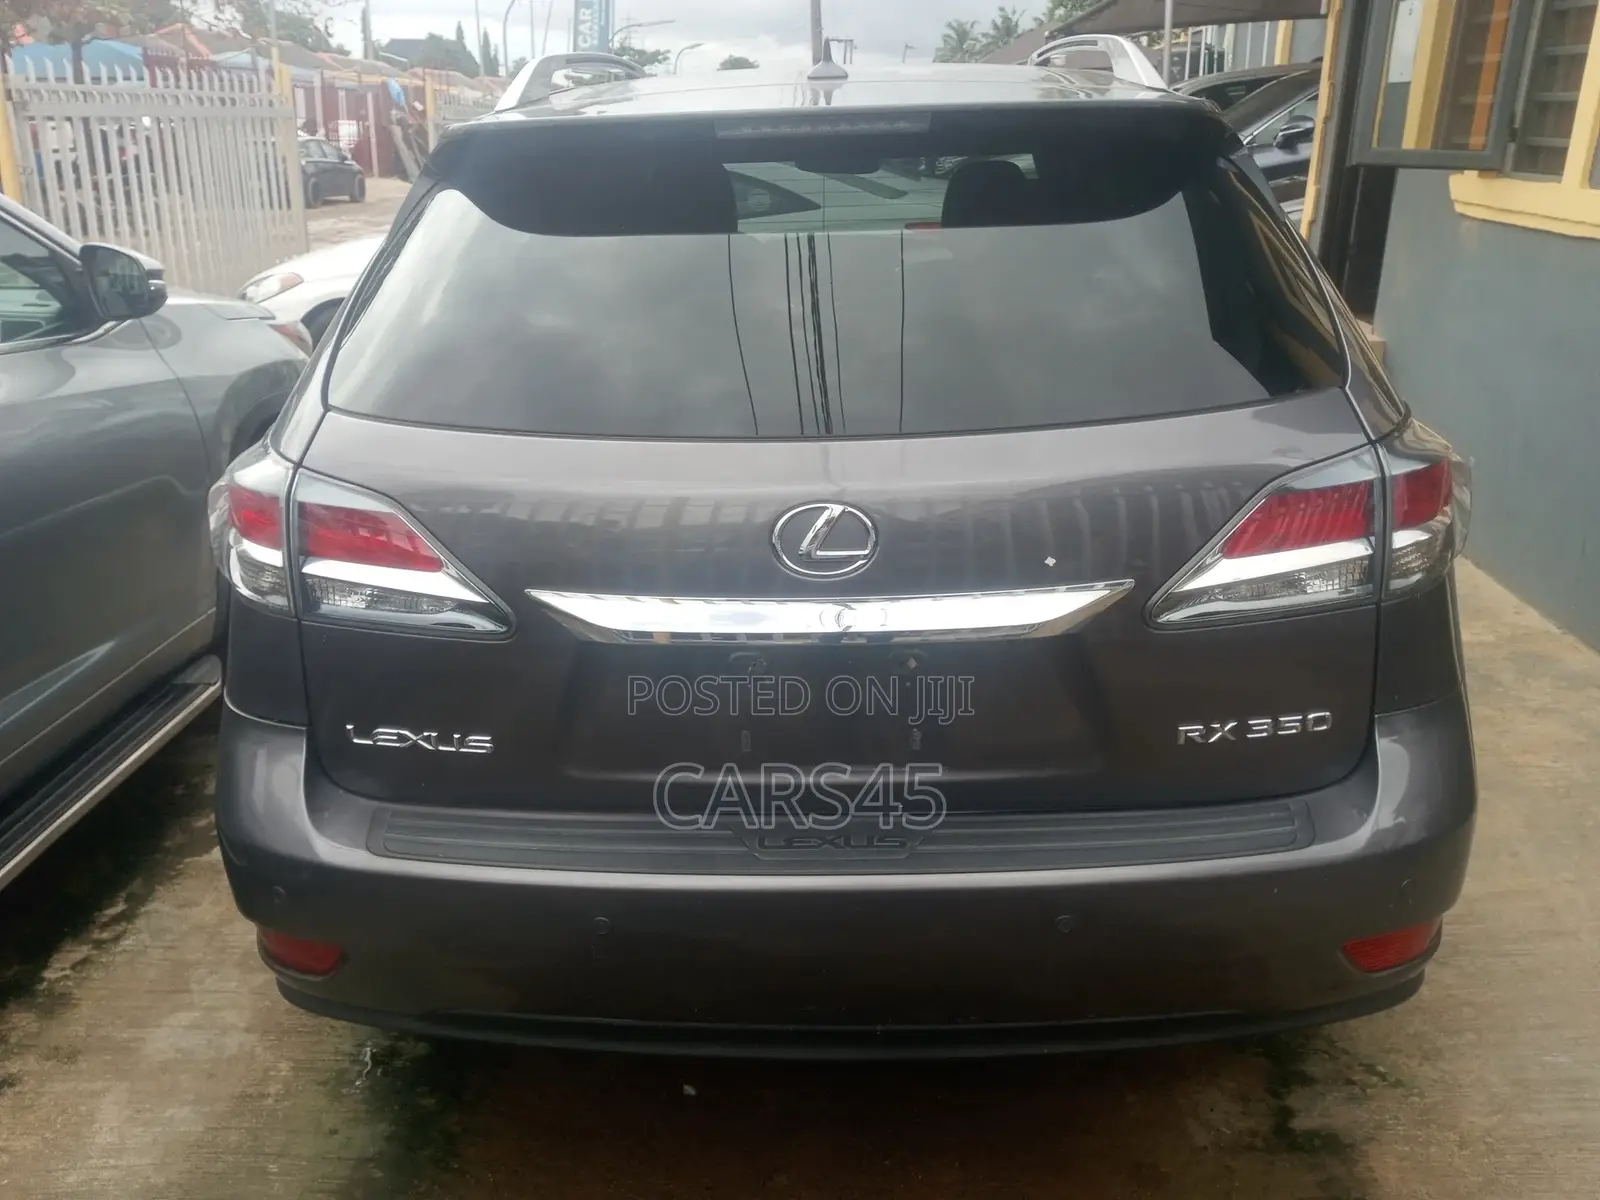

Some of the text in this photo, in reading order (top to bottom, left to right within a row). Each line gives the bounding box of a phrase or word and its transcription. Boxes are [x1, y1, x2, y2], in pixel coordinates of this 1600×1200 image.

[345, 724, 494, 754] LEXUS
[1177, 711, 1333, 745] RX 350
[756, 835, 909, 850] LEXUS
